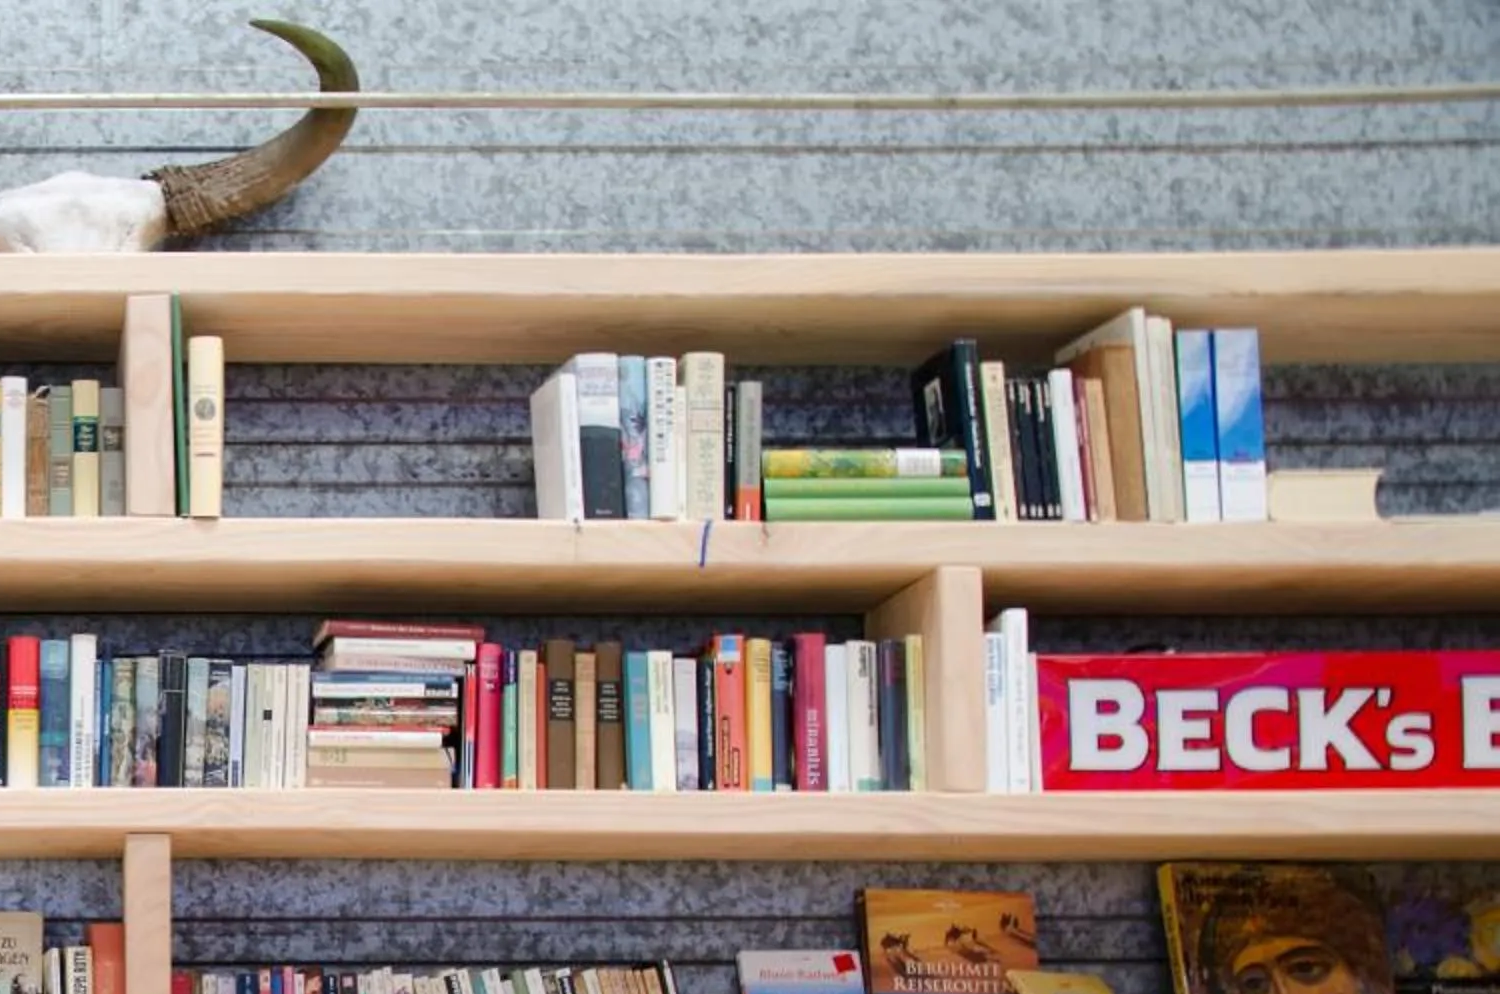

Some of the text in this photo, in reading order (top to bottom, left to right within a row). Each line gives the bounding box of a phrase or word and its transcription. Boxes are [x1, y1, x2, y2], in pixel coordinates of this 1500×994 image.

[1067, 678, 1436, 771] BECK's
[73, 951, 87, 973] ROTH
[906, 959, 999, 977] BERÜHMTE
